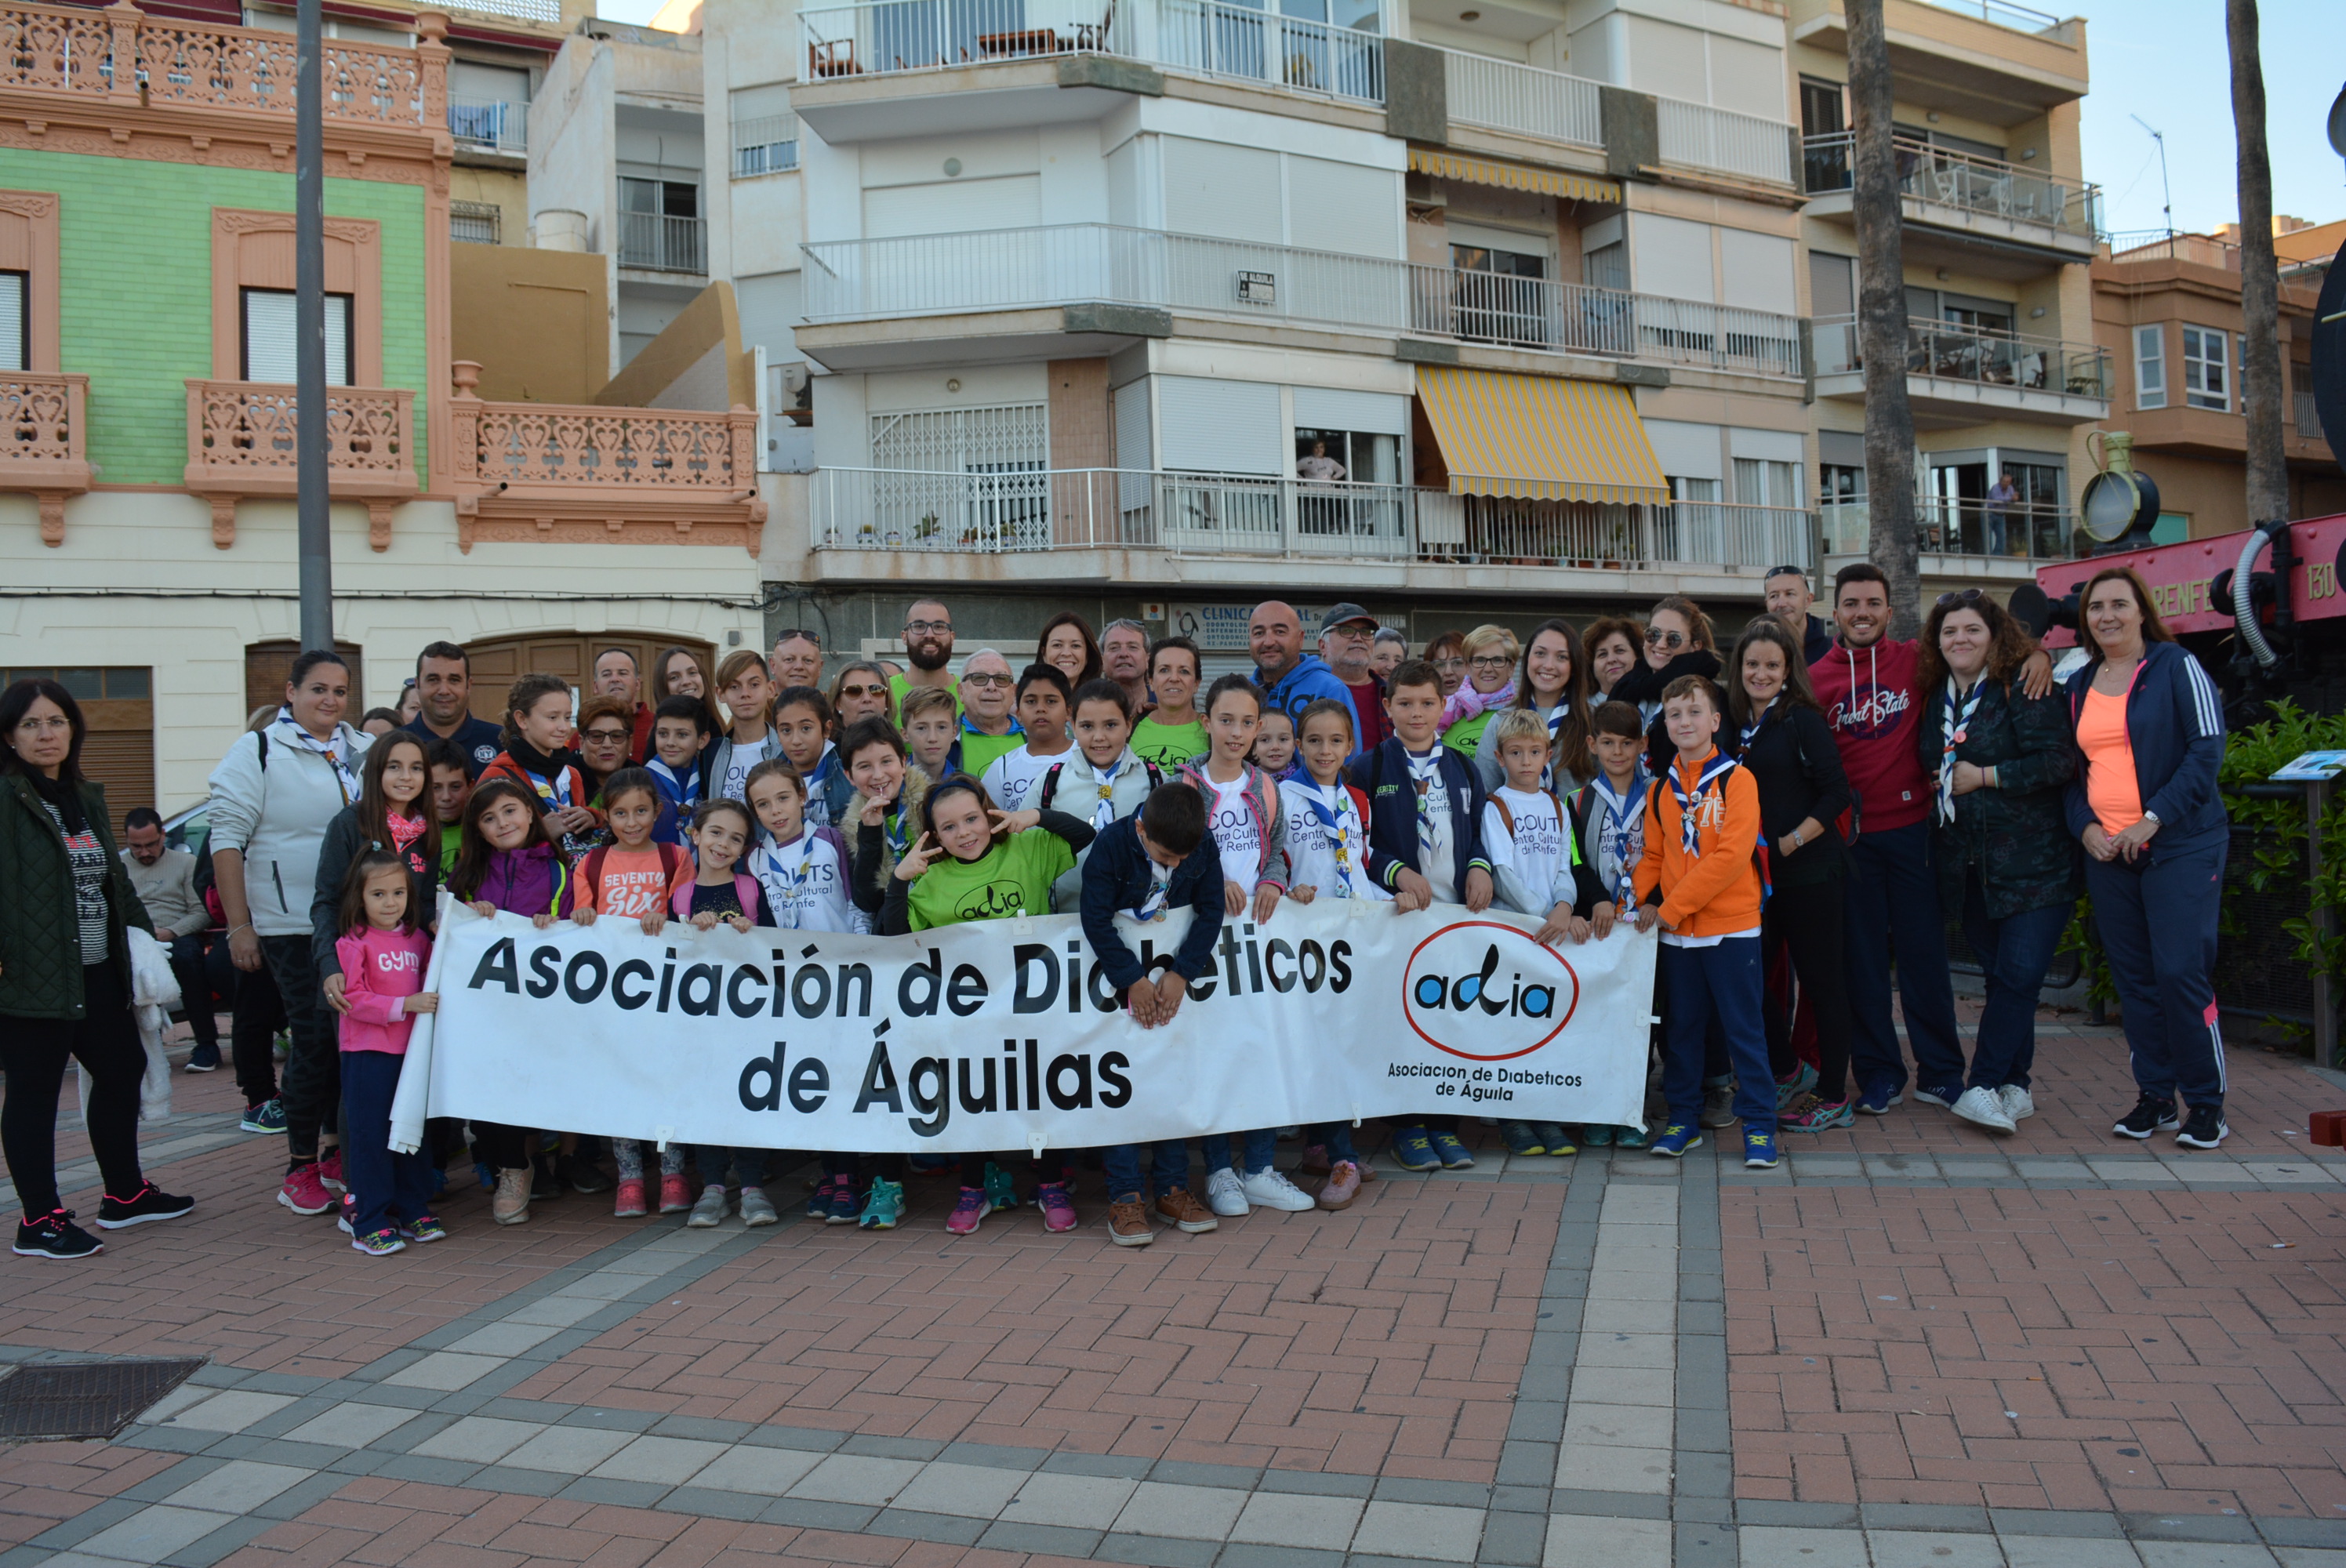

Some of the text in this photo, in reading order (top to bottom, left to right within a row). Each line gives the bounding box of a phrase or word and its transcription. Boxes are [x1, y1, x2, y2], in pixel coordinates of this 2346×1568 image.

[1249, 273, 1273, 284] ALQUILA
[2307, 561, 2336, 601] 130
[2152, 578, 2215, 618] RENFE
[1828, 688, 1910, 732] Great State
[1292, 829, 1326, 844] Centr
[1514, 815, 1558, 833] COUT
[605, 871, 666, 887] SEVENTY
[605, 885, 661, 916] Six
[962, 884, 1022, 919] adia
[467, 937, 872, 1018] Asociación
[897, 948, 990, 1017] de
[1414, 943, 1556, 1018] adia
[738, 1018, 1132, 1138] de Águilas
[1388, 1062, 1582, 1087] Asociacion de Diabeticos
[1436, 1080, 1513, 1102] de Águila
